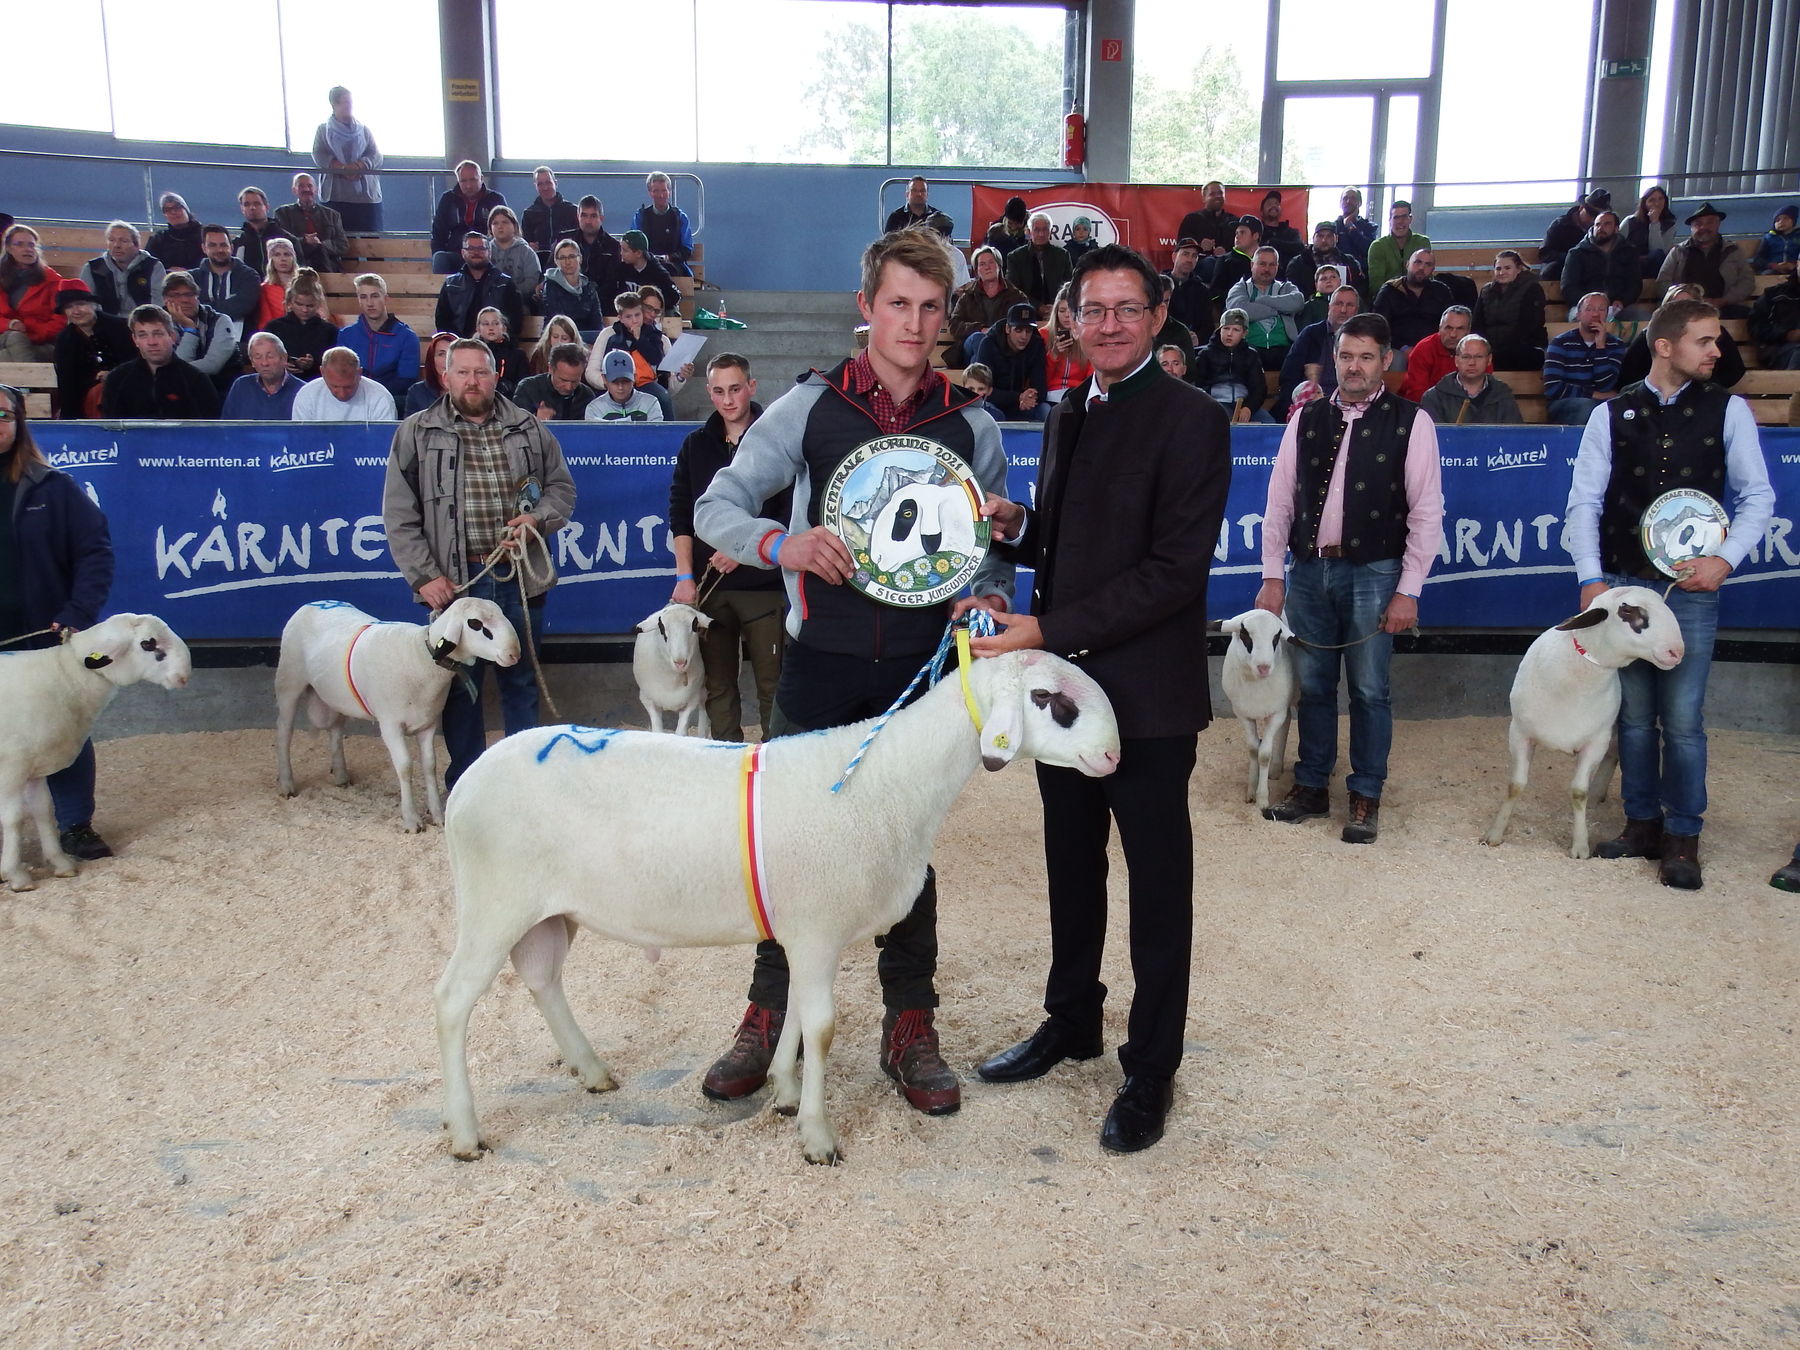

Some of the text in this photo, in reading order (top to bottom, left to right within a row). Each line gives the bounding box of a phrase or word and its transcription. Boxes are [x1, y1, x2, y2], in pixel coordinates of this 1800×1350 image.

[1049, 220, 1103, 241] RAT
[139, 455, 261, 468] www.kaernten.at
[825, 449, 865, 527] ZENTRALE
[934, 446, 964, 472] 2021
[875, 554, 982, 604] SIEGER JUNGWIDDER
